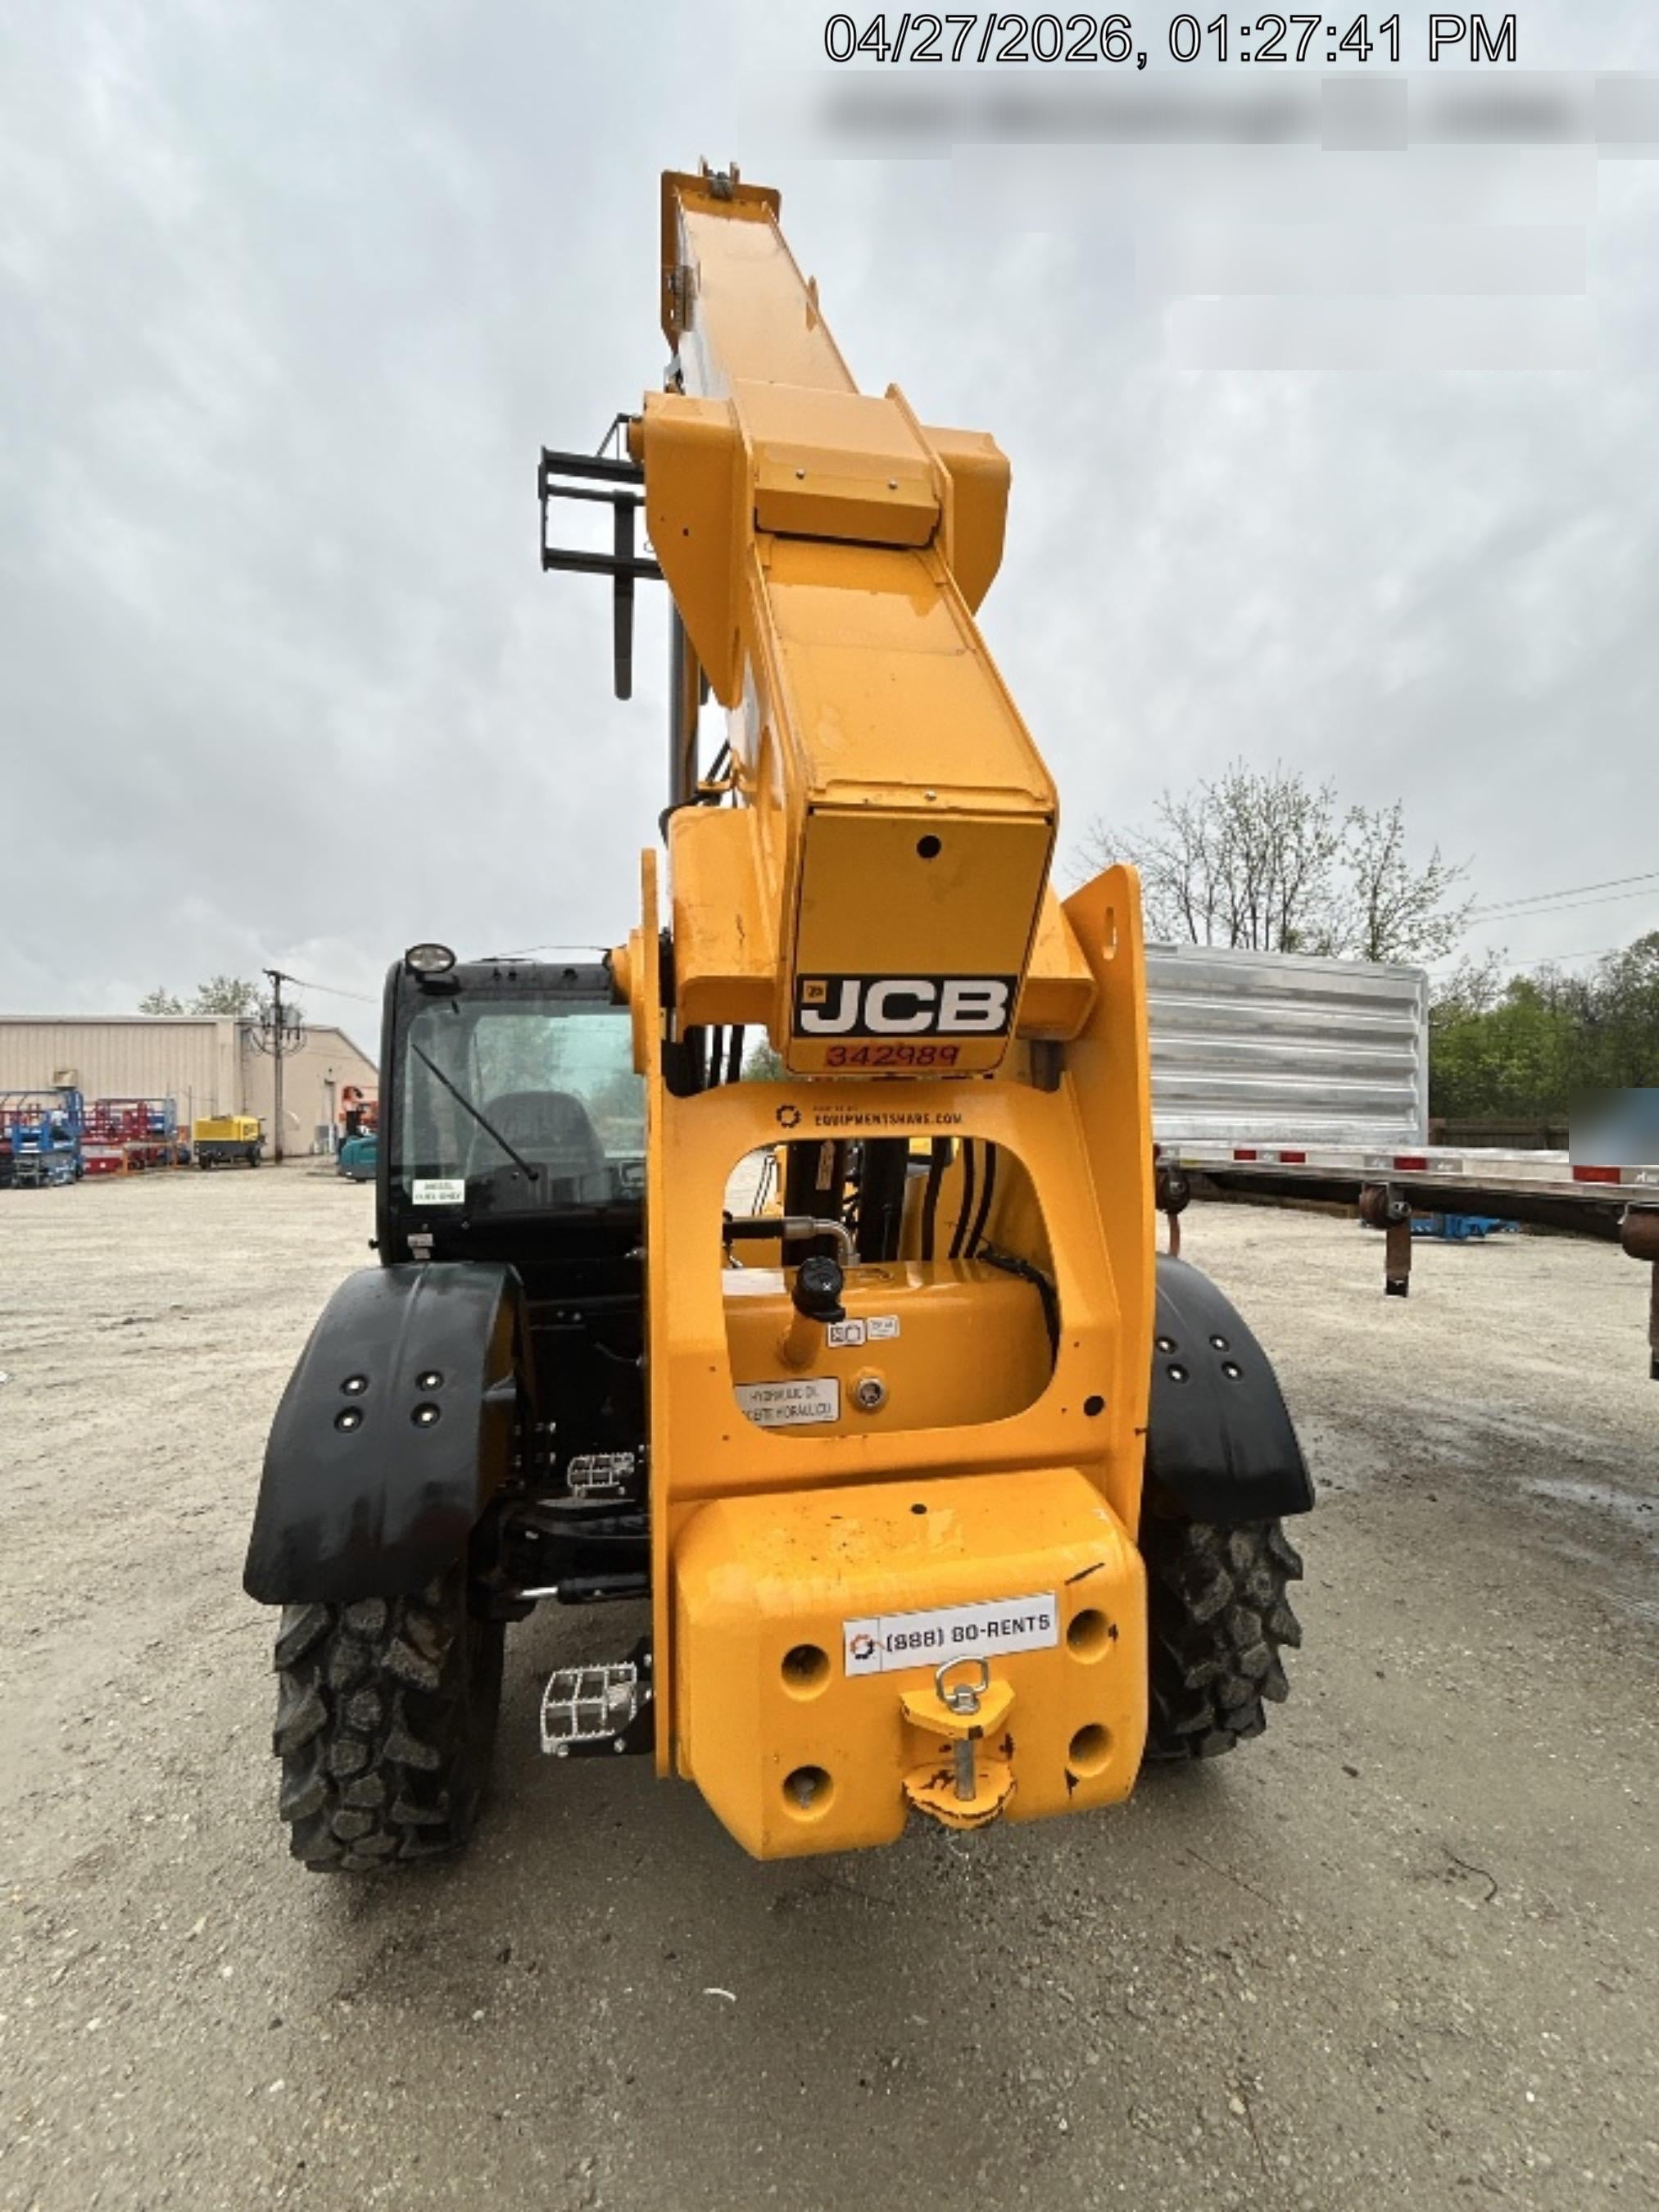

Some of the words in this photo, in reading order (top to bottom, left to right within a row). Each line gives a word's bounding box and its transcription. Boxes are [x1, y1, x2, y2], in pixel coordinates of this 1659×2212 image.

[800, 979, 1009, 1033] JCB
[827, 1044, 960, 1067] 342989
[886, 1628, 945, 1653] (888)
